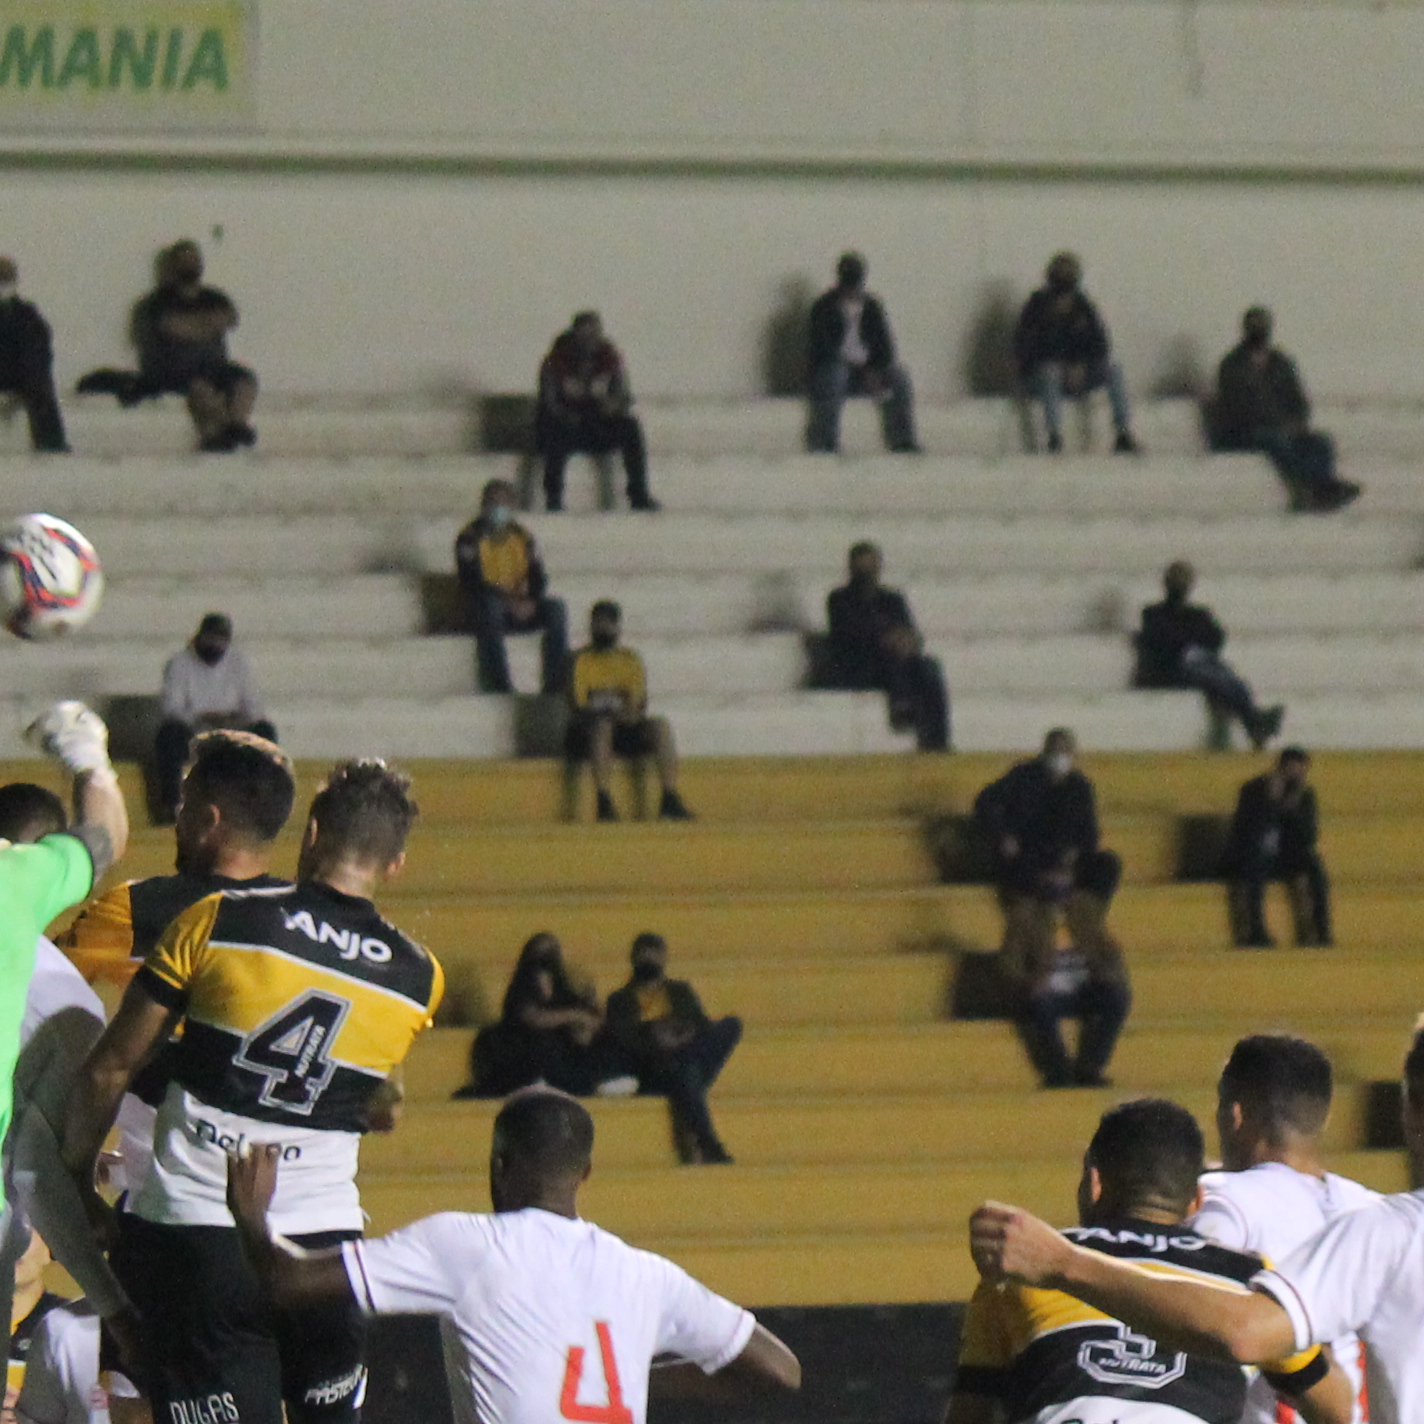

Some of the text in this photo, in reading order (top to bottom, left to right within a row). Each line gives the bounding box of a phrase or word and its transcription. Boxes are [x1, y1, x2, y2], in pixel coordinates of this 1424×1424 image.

[282, 908, 393, 964] ANJO
[232, 987, 353, 1116] 4
[1062, 1226, 1208, 1253] ANJO
